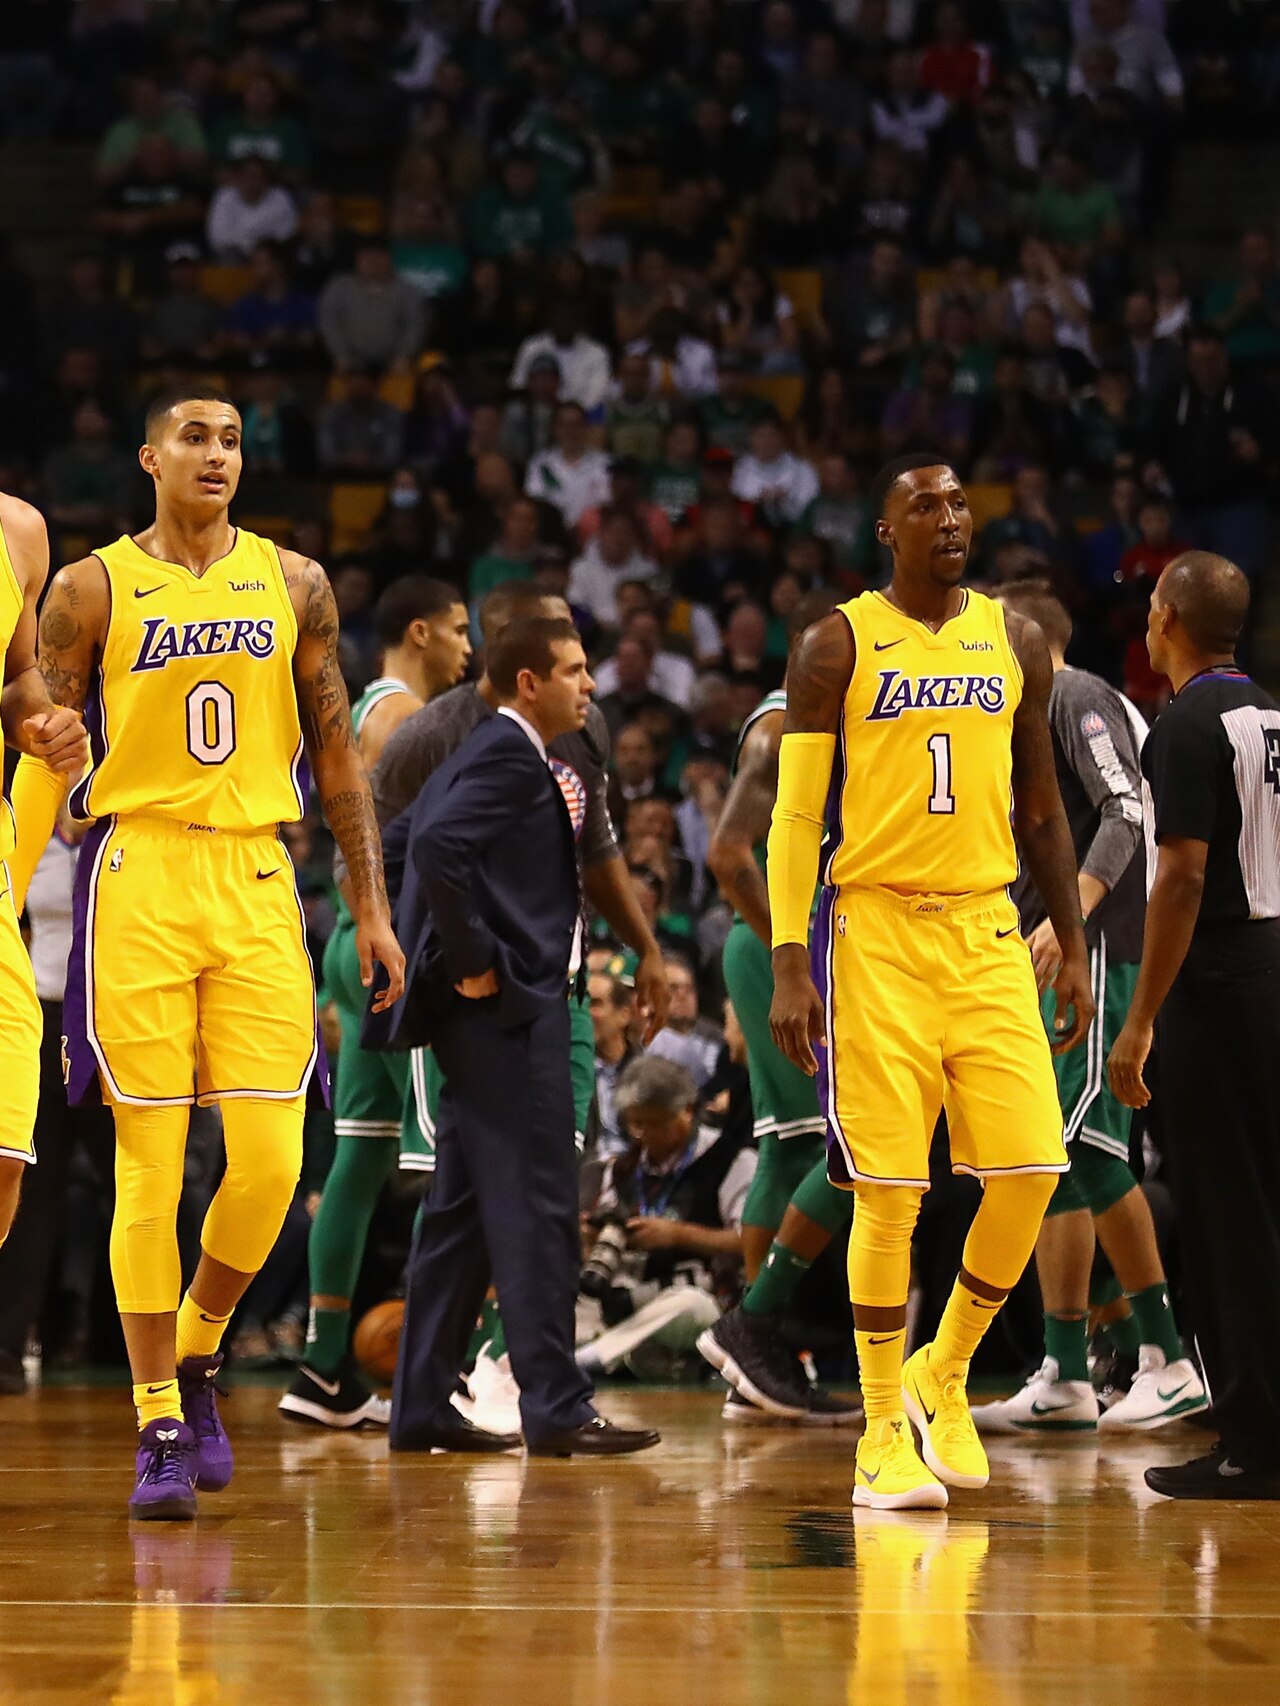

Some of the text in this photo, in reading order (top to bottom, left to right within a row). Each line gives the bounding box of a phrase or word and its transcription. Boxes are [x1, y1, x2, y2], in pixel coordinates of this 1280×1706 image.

[228, 580, 266, 592] wish
[130, 616, 276, 673] LAKERS
[959, 639, 993, 652] wish
[865, 669, 1007, 721] LAKERS
[185, 681, 236, 766] 0
[926, 733, 956, 814] 1
